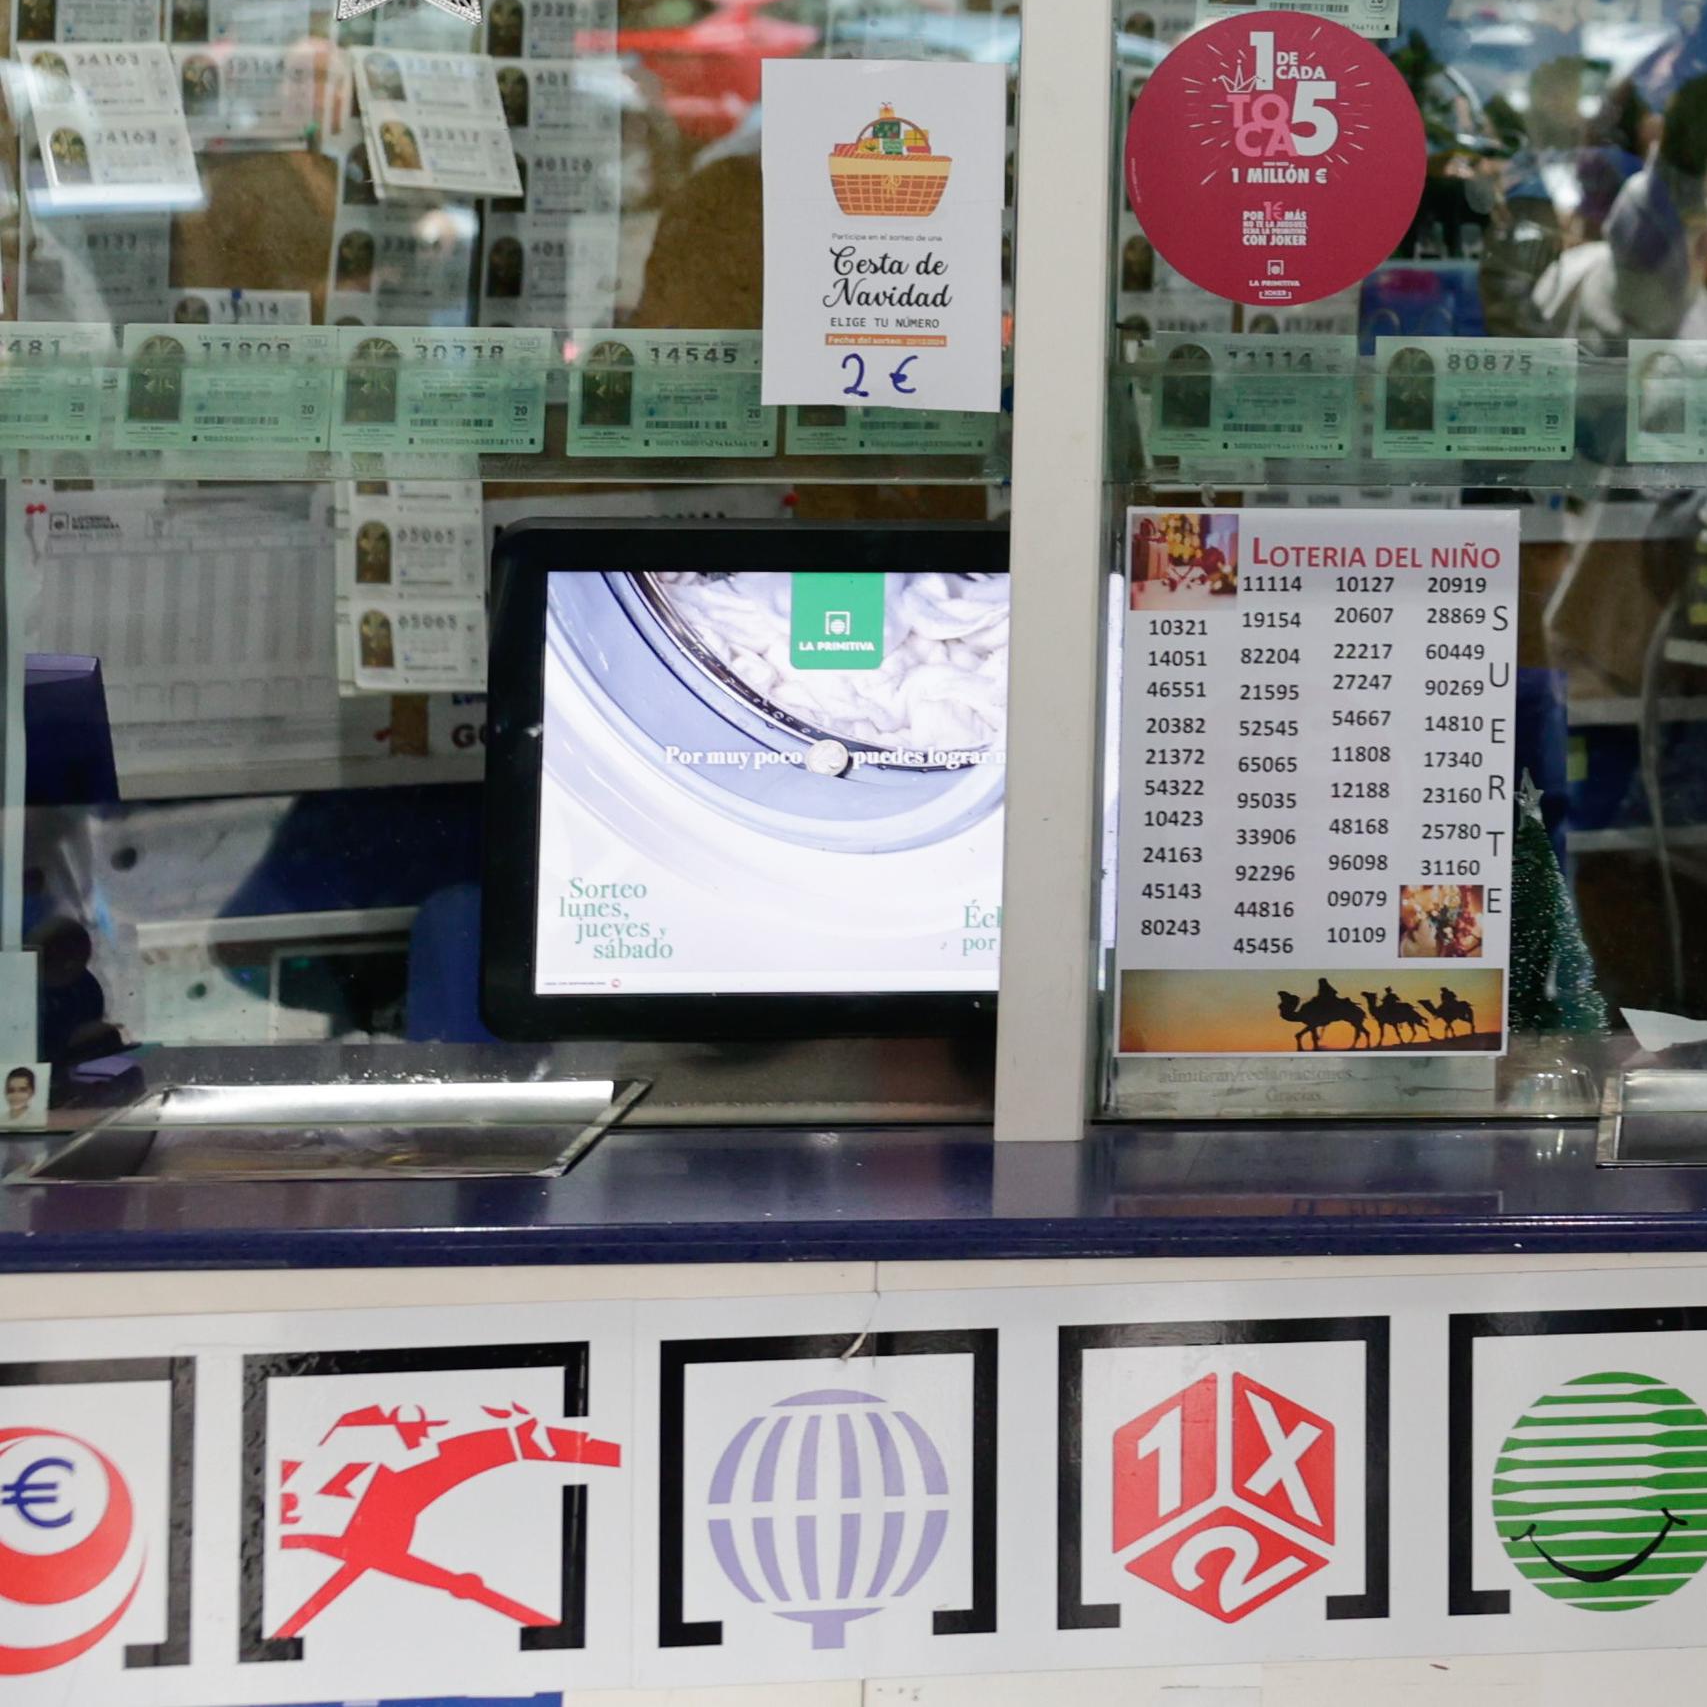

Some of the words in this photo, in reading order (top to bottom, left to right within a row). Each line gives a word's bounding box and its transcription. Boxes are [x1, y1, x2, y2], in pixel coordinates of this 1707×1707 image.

[1276, 51, 1299, 65] DE
[1275, 65, 1326, 79] CADA
[1290, 81, 1339, 157] 5
[1231, 167, 1240, 183] 1
[1247, 163, 1311, 184] MILLÓN
[1314, 168, 1328, 184] €
[1243, 211, 1264, 221] POR
[1284, 209, 1307, 221] MÁS
[1243, 235, 1267, 246] CON
[1269, 235, 1307, 246] JOKER
[830, 246, 909, 276] Cesta
[916, 252, 948, 275] de
[822, 277, 952, 308] Navidad
[830, 317, 866, 327] ELIGE
[874, 318, 889, 327] TU
[895, 315, 940, 328] NÚMERO
[650, 347, 738, 365] 14545
[1447, 353, 1533, 372] 80875
[841, 353, 869, 398] 2
[889, 355, 918, 394] €
[1252, 537, 1371, 568] LOTERIA
[1375, 547, 1422, 568] DEL
[1430, 542, 1501, 570] NIÑO
[1242, 575, 1303, 594] 11114
[1334, 575, 1395, 594] 10127
[1426, 576, 1487, 595] 20919
[1241, 611, 1302, 630] 19154
[1333, 607, 1394, 626] 20607
[1426, 607, 1487, 626] 28869
[1147, 619, 1208, 638] 10321
[800, 641, 814, 651] LA
[817, 641, 875, 652] PRIMITIVA
[1332, 643, 1393, 662] 22217
[1424, 643, 1485, 662] 60449
[1147, 650, 1208, 669] 14051
[1240, 647, 1301, 666] 82204
[1146, 681, 1207, 700] 46551
[1239, 683, 1300, 702] 21595
[1332, 674, 1393, 693] 27247
[1424, 679, 1485, 698] 90269
[1145, 717, 1206, 736] 20382
[1238, 720, 1299, 739] 52545
[1331, 709, 1392, 728] 54667
[1423, 715, 1484, 734] 14810
[665, 747, 704, 765] Por
[706, 750, 748, 769] muy
[755, 750, 803, 769] poco
[853, 747, 926, 770] puedes
[927, 747, 993, 770] lograr
[1144, 748, 1205, 767] 21372
[1237, 756, 1298, 775] 65065
[1331, 746, 1392, 765] 11808
[1423, 751, 1484, 770] 17340
[1144, 778, 1205, 797] 54322
[1330, 781, 1391, 800] 12188
[1421, 787, 1482, 806] 23160
[1237, 792, 1298, 811] 95035
[1143, 810, 1204, 829] 10423
[1235, 828, 1296, 847] 33906
[1328, 818, 1389, 837] 48168
[1421, 823, 1482, 842] 25780
[1142, 846, 1203, 865] 24163
[1234, 864, 1295, 883] 92296
[1327, 854, 1388, 873] 96098
[1420, 859, 1481, 878] 31160
[569, 877, 648, 899] Sorteo
[1141, 882, 1202, 901] 45143
[560, 896, 629, 919] lunes,
[1326, 890, 1387, 909] 09079
[1233, 901, 1294, 920] 44816
[575, 917, 650, 944] jueves
[1140, 918, 1201, 937] 80243
[1326, 926, 1387, 945] 10109
[593, 938, 673, 959] sábado
[962, 938, 997, 957] por
[1232, 936, 1293, 955] 45456
